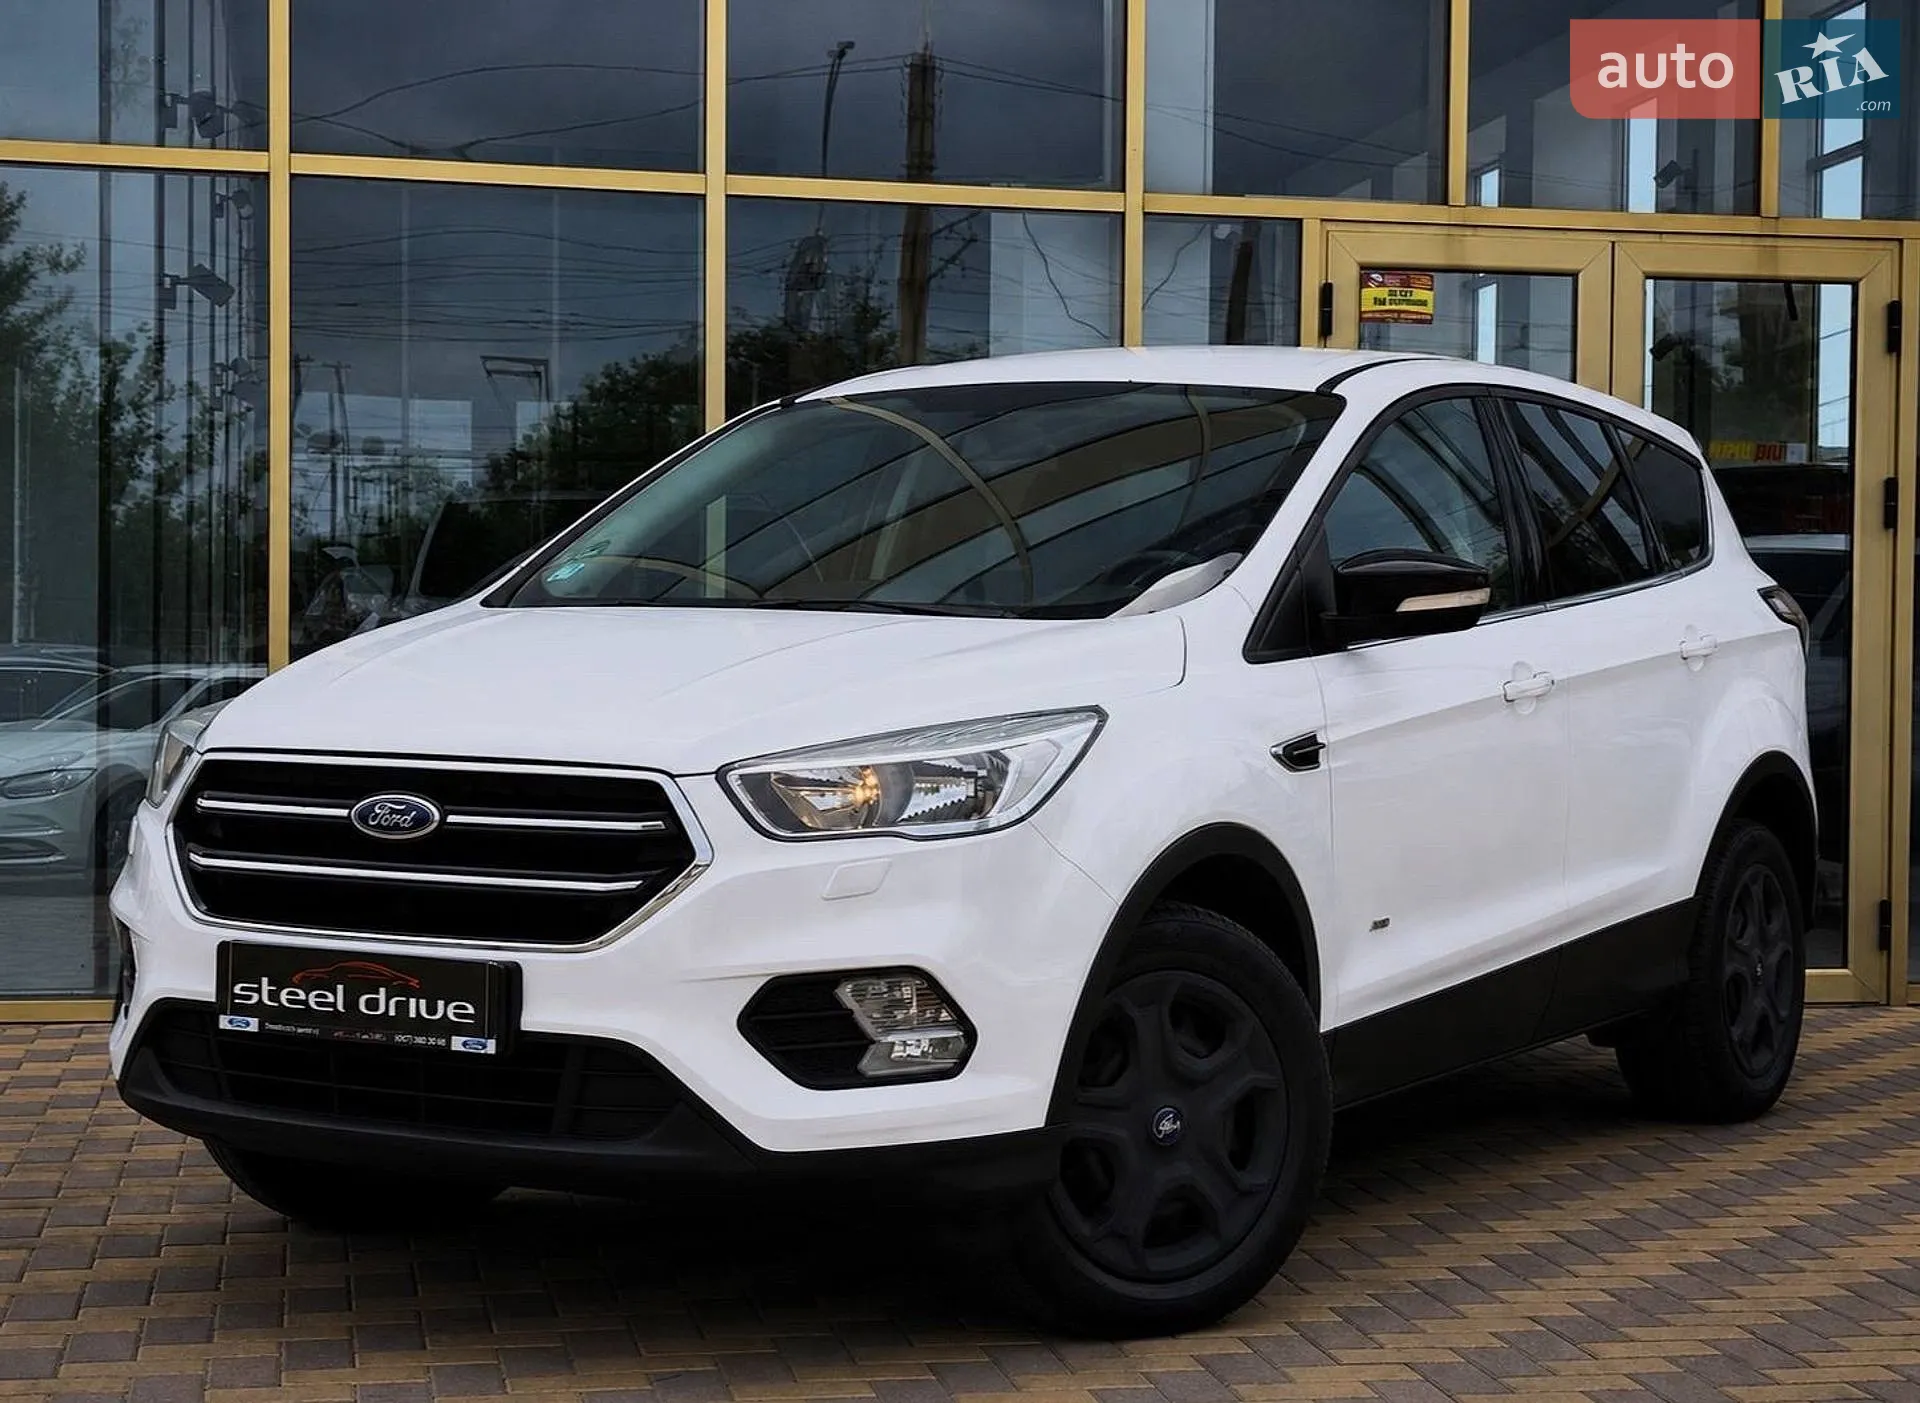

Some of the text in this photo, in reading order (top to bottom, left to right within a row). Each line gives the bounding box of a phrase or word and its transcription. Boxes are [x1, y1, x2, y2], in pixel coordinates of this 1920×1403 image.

[368, 802, 417, 828] Ford
[233, 976, 476, 1023] steel drive
